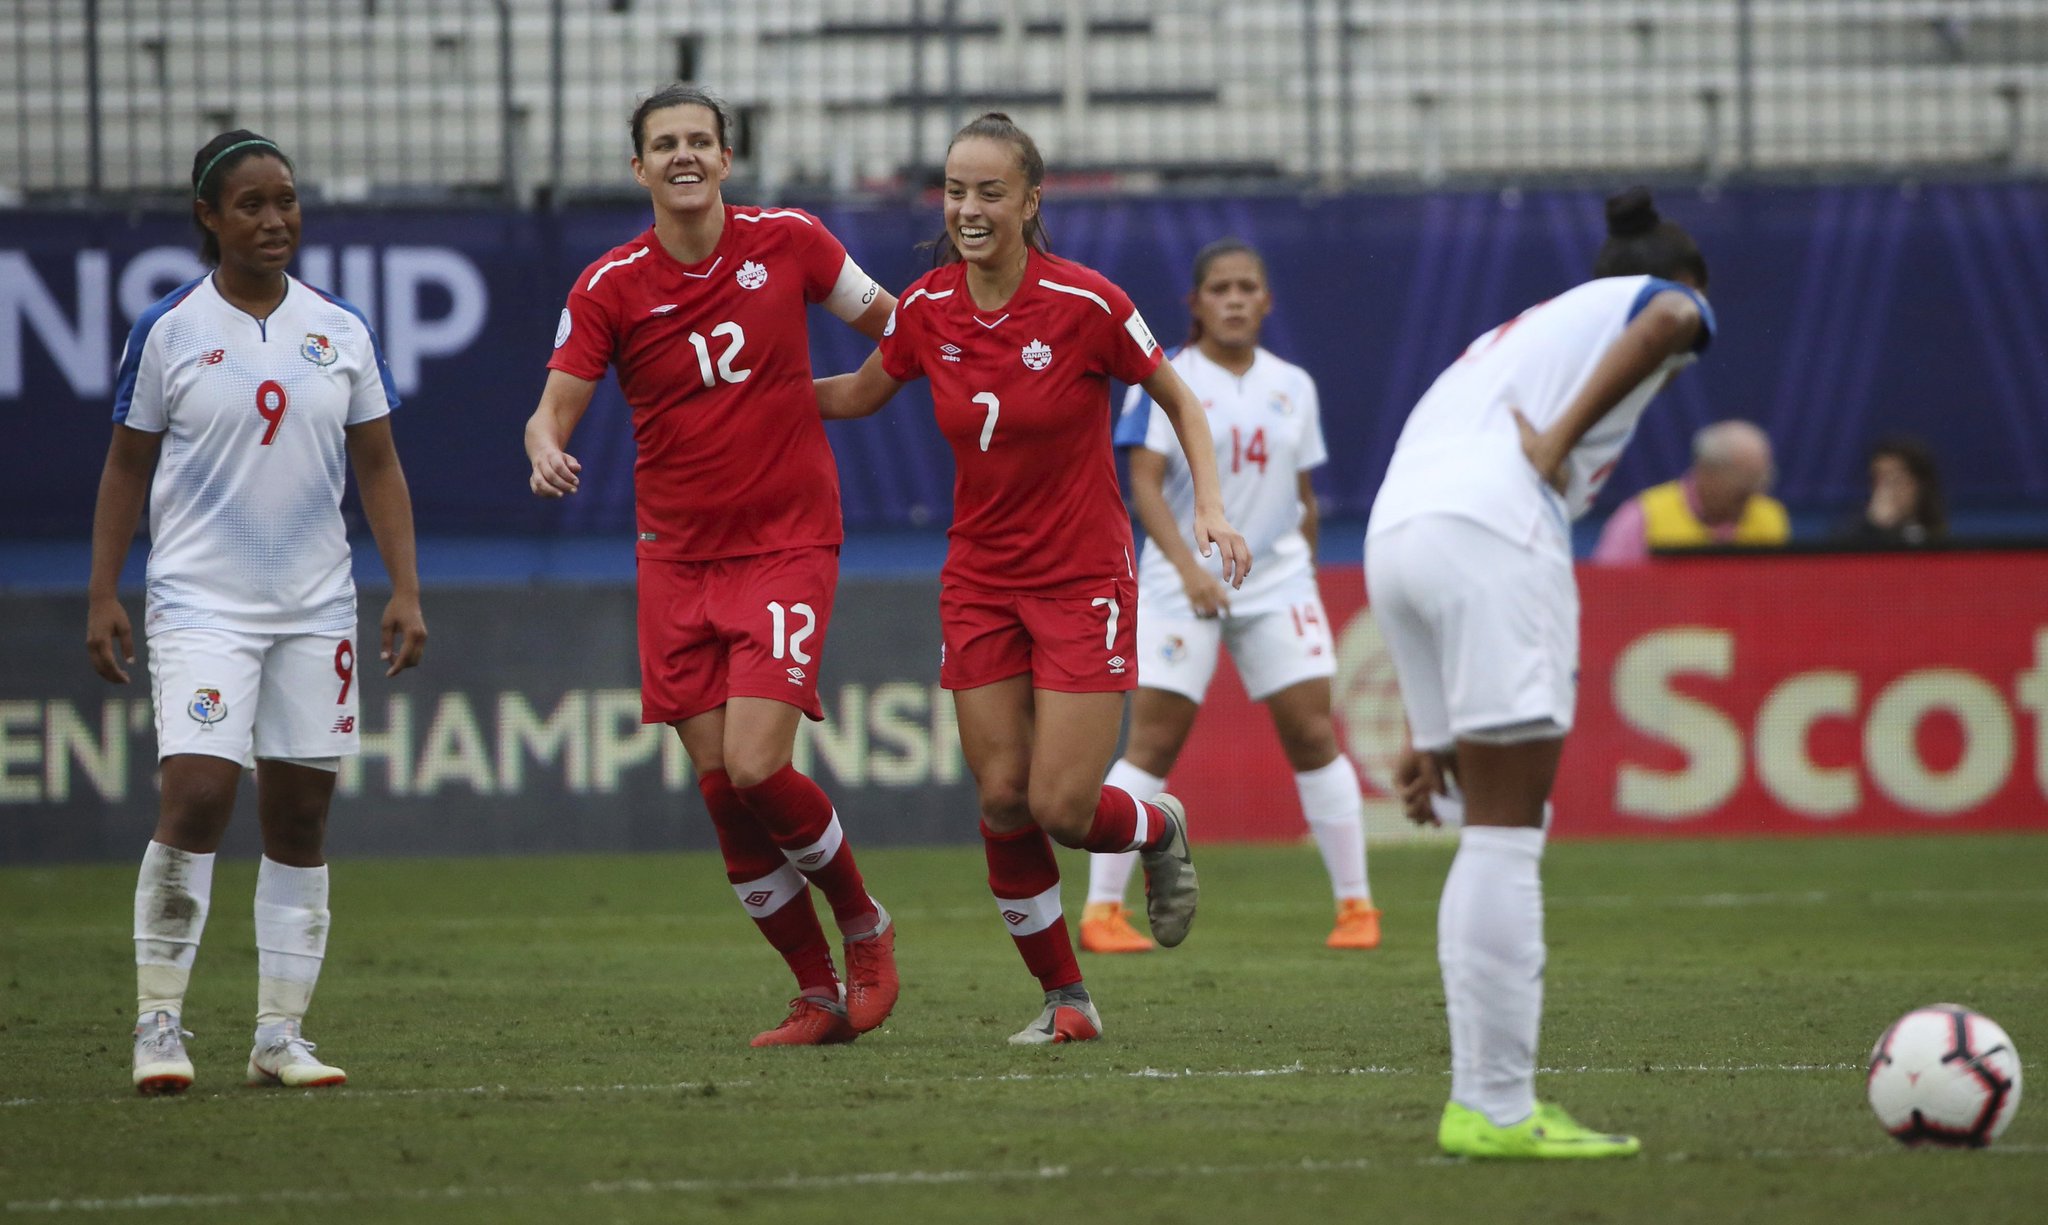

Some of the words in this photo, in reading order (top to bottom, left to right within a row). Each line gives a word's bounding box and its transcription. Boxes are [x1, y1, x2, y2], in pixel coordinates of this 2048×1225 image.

[688, 321, 752, 387] 12
[256, 380, 288, 445] 9
[971, 391, 1000, 452] 7
[1231, 427, 1268, 474] 14
[767, 601, 817, 665] 12
[1091, 597, 1120, 651] 7
[1290, 603, 1320, 637] 14
[334, 639, 354, 705] 9
